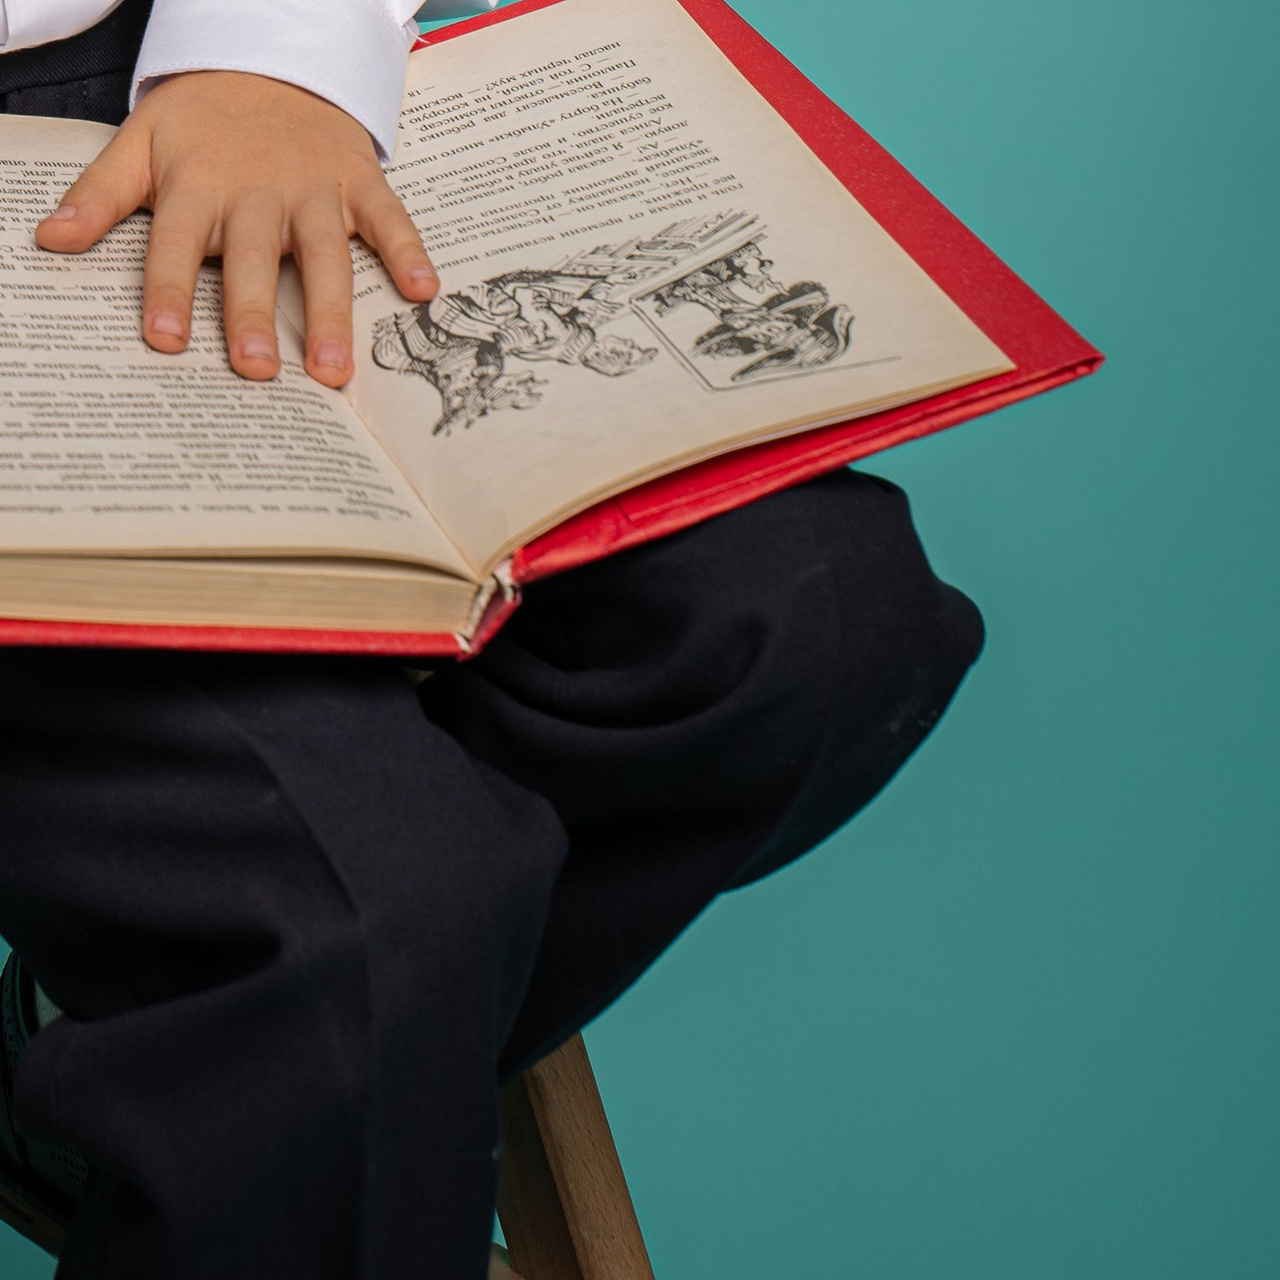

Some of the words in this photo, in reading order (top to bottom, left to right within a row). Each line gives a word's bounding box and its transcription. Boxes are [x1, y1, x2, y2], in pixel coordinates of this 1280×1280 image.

[574, 42, 621, 60] наслал
[519, 59, 571, 78] черных
[549, 68, 575, 80] той
[486, 75, 517, 91] мух?
[496, 78, 544, 96] самой,
[587, 76, 651, 99] бабушка.
[408, 89, 421, 98] 18
[474, 95, 491, 103] на
[490, 89, 544, 109] ответил
[516, 81, 604, 113] Восемьдесят
[602, 97, 623, 106] На
[409, 102, 469, 124] которую
[561, 104, 600, 121] борту
[592, 94, 666, 120] встречали.
[649, 103, 673, 114] кое
[416, 107, 487, 132] комиссар.
[483, 111, 506, 122] два
[572, 112, 643, 137] существо,
[419, 120, 476, 142] ребенка
[488, 119, 555, 142] «Улыбки»
[619, 117, 661, 135] Алиса
[441, 141, 484, 157] много
[513, 142, 551, 157] возле
[570, 134, 612, 149] знала,
[612, 142, 623, 150] Я
[636, 141, 658, 154] Ах!
[542, 150, 567, 159] что
[561, 146, 608, 165] сейчас
[645, 148, 709, 172] звездный
[426, 156, 507, 184] Солнечной
[460, 157, 536, 182] дракончик
[518, 161, 558, 177] упаду
[568, 156, 614, 173] сказал
[655, 156, 720, 178] космосе,
[518, 170, 564, 186] робот,
[562, 169, 638, 196] дракончик
[412, 187, 432, 196] это
[436, 178, 502, 201] обморок!
[440, 185, 515, 208] незаметно
[569, 177, 650, 205] неподалеку
[597, 190, 644, 207] сказал
[640, 182, 709, 204] прежних.
[480, 194, 555, 217] проглотил
[546, 202, 562, 210] от
[649, 198, 693, 214] время
[457, 209, 540, 234] Солнечной
[628, 212, 644, 220] от
[480, 215, 555, 237] Несчастье
[560, 217, 623, 238] времени
[485, 235, 555, 257] вставляет
[0, 283, 56, 291] заявила
[13, 293, 96, 301] специалист
